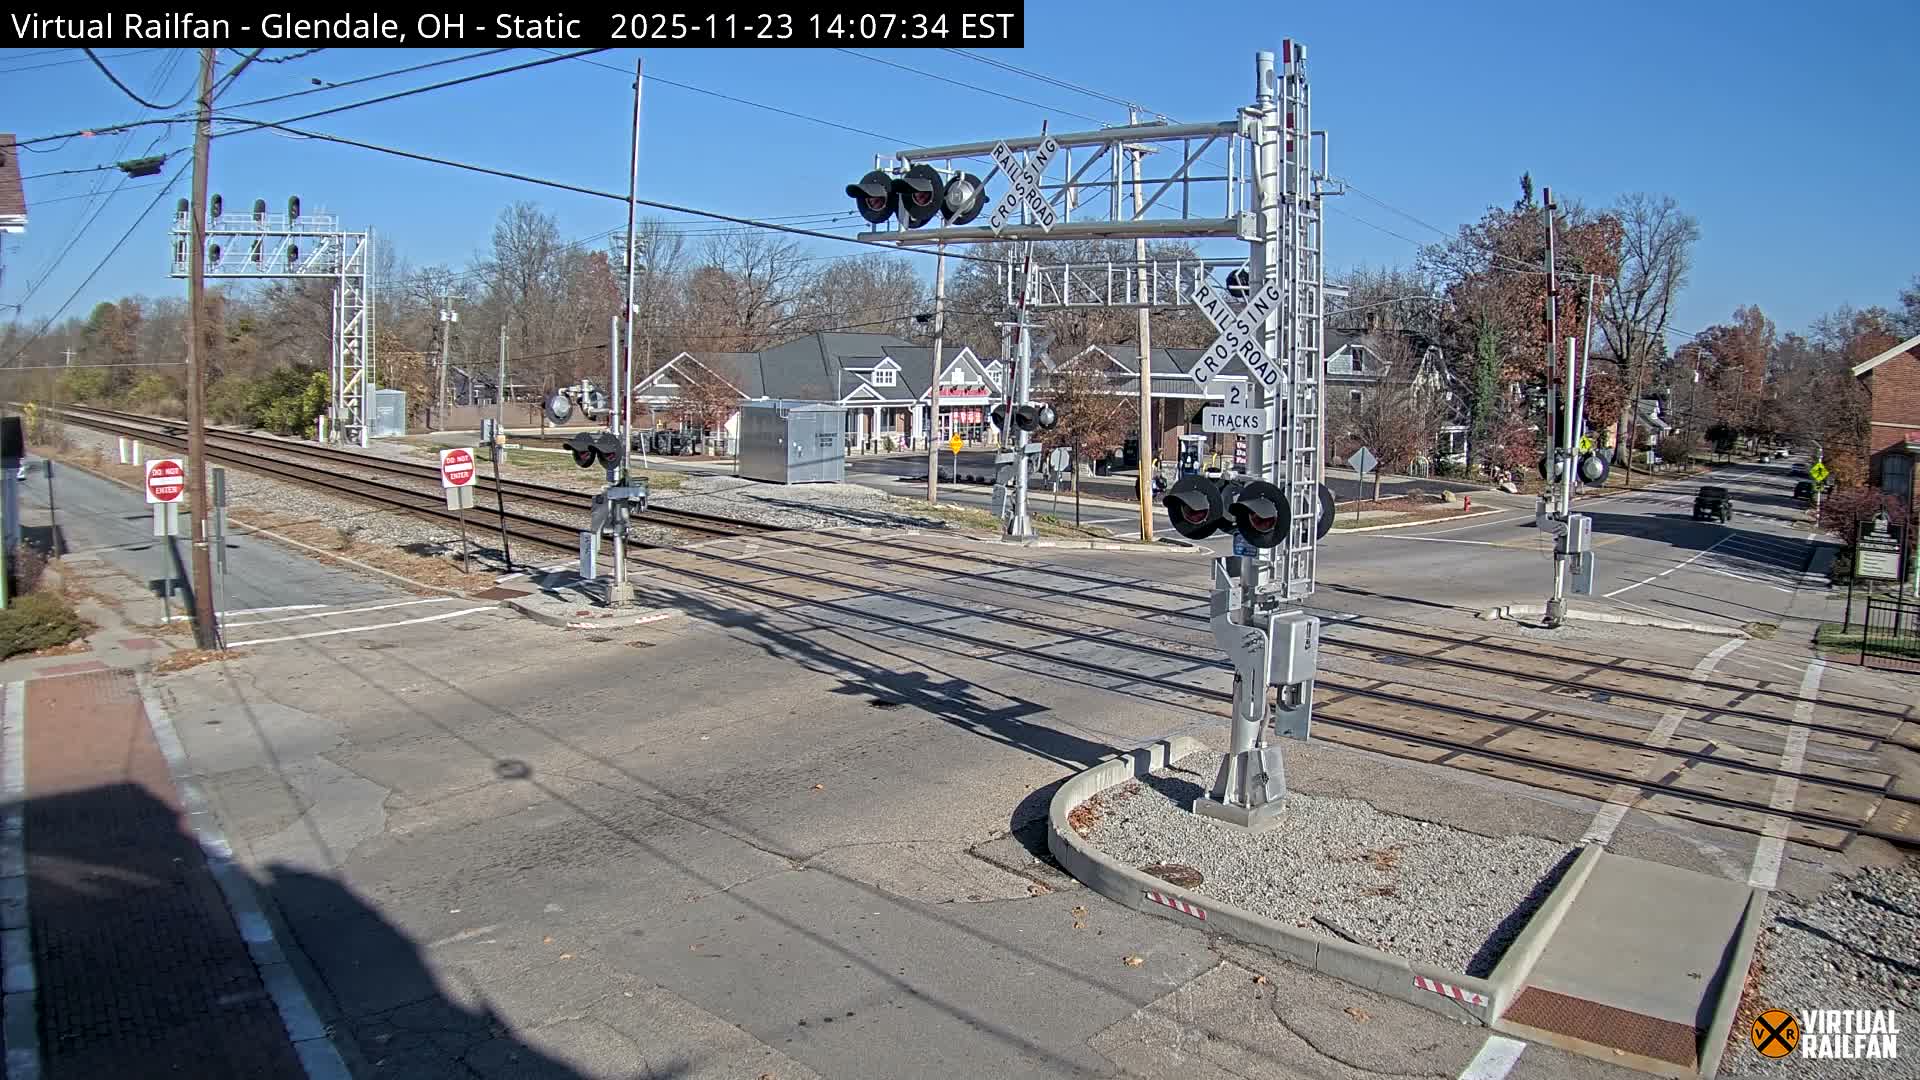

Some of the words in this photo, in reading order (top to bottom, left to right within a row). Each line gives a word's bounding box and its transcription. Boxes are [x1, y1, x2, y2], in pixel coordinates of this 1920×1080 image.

[990, 138, 1056, 230] CROSSING
[1194, 285, 1281, 384] CROSSING
[1230, 387, 1241, 404] 2
[1210, 413, 1259, 429] TRACKS
[165, 467, 179, 475] NOT
[449, 472, 469, 480] ENTER
[155, 486, 177, 494] ENTER
